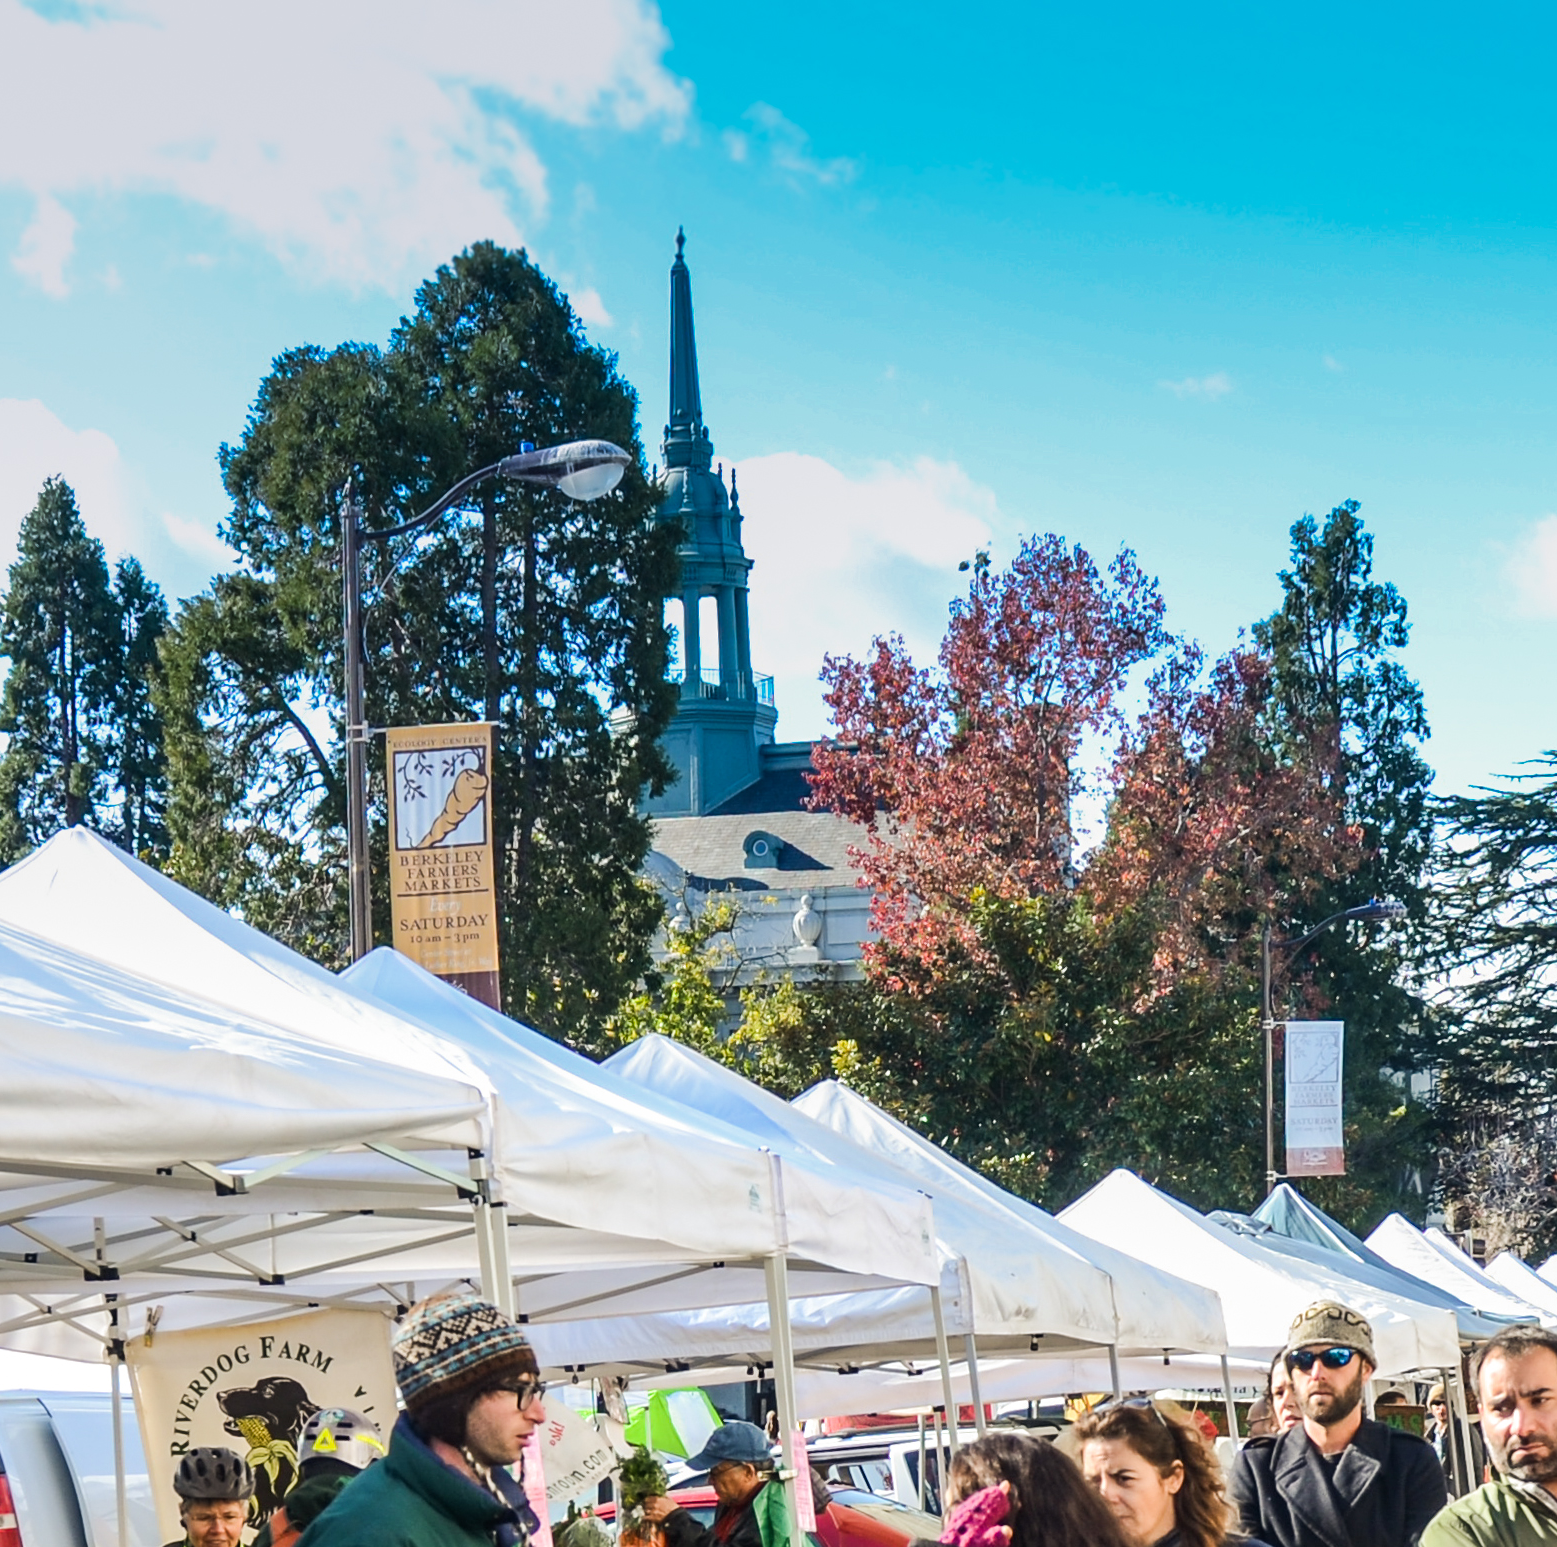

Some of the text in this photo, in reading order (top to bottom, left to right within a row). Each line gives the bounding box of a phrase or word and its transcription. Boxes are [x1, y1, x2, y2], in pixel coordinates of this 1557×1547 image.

[393, 738, 436, 748] ECOLOGY
[400, 851, 484, 867] BERKELEY
[407, 864, 479, 879] FARMERS
[404, 877, 481, 892] MARKETS
[429, 898, 461, 916] Every
[400, 914, 489, 932] SATURDAY
[410, 935, 423, 944] 10
[425, 935, 442, 943] am
[462, 932, 480, 943] pm
[1291, 1117, 1339, 1126] SATURDAY
[170, 1335, 335, 1458] RIVERDOG FARM
